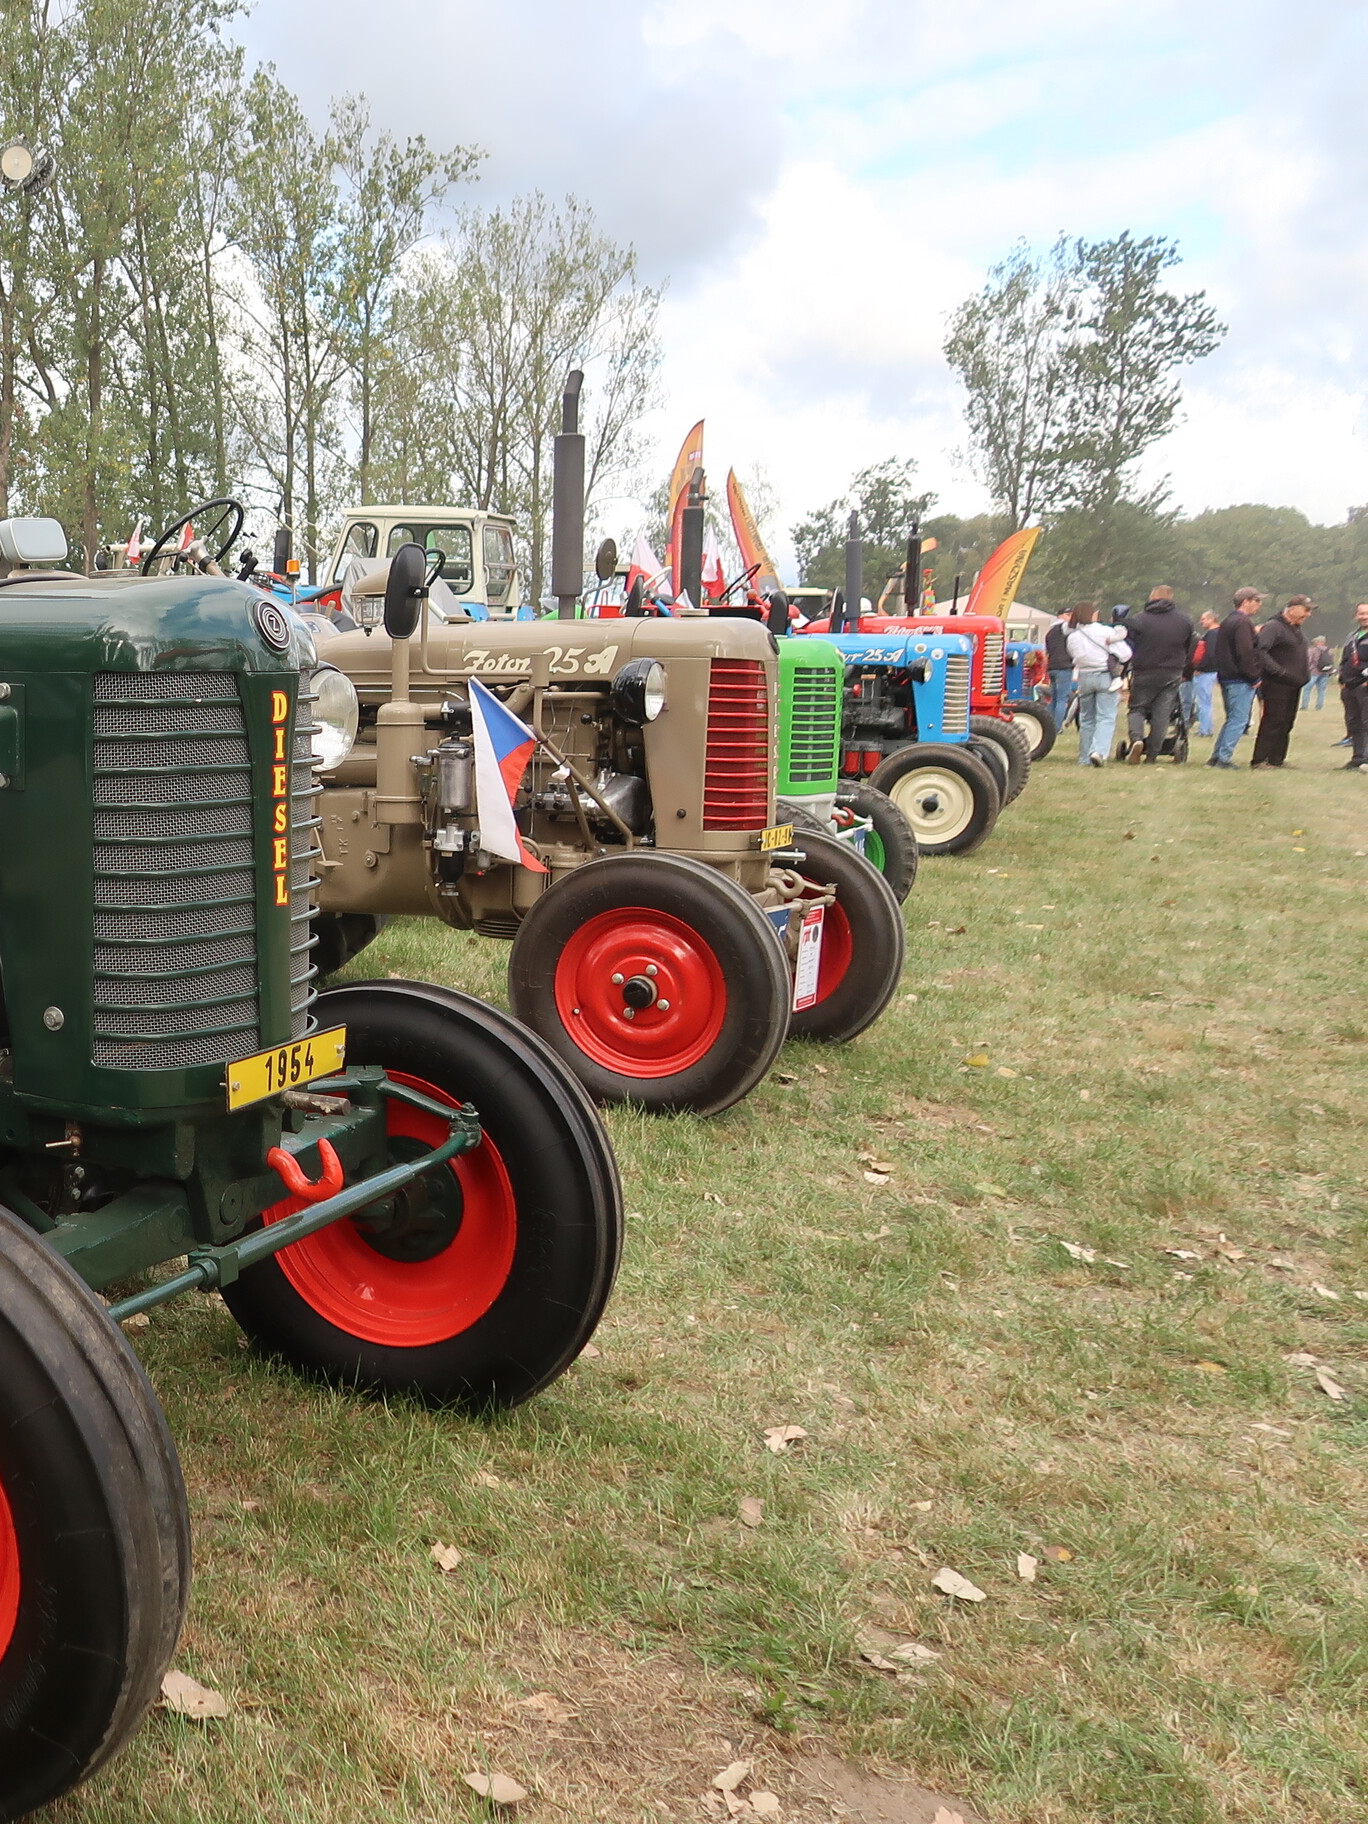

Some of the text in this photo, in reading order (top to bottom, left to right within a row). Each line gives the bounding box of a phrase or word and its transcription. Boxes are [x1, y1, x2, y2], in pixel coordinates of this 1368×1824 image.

[542, 646, 586, 674] 25
[583, 645, 619, 674] A
[862, 648, 885, 662] 25
[883, 648, 905, 663] A
[271, 690, 289, 906] DIESEL
[265, 1043, 314, 1092] 1954
